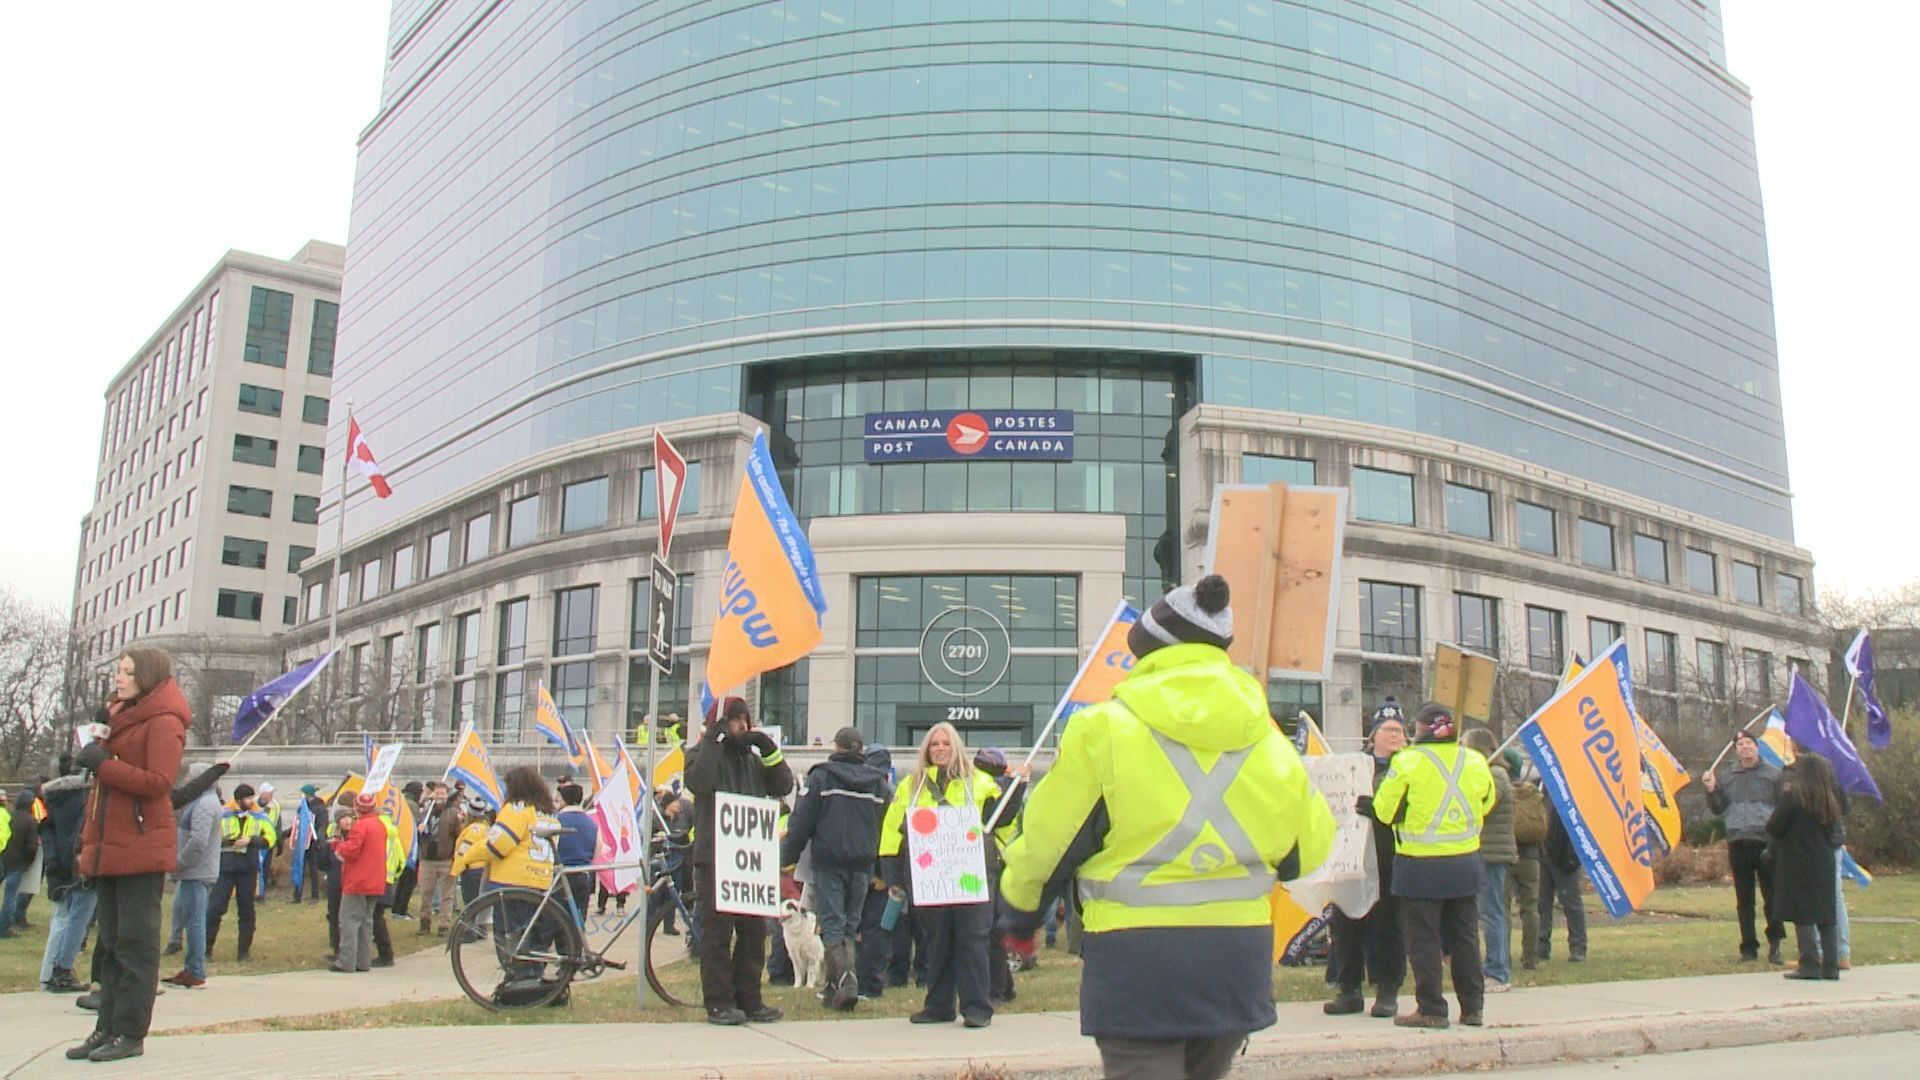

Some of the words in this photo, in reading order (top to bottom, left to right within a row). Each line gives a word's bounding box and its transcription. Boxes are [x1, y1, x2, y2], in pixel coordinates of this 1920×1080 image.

[873, 418, 942, 431] CANADA
[994, 416, 1056, 429] POSTES
[873, 441, 913, 454] POST
[994, 439, 1065, 452] CANADA
[948, 645, 982, 659] 2701
[947, 706, 980, 720] 2701
[720, 803, 775, 841] CUPW
[1574, 825, 1599, 861] struggle
[735, 848, 762, 871] ON
[721, 880, 776, 905] STRIKE
